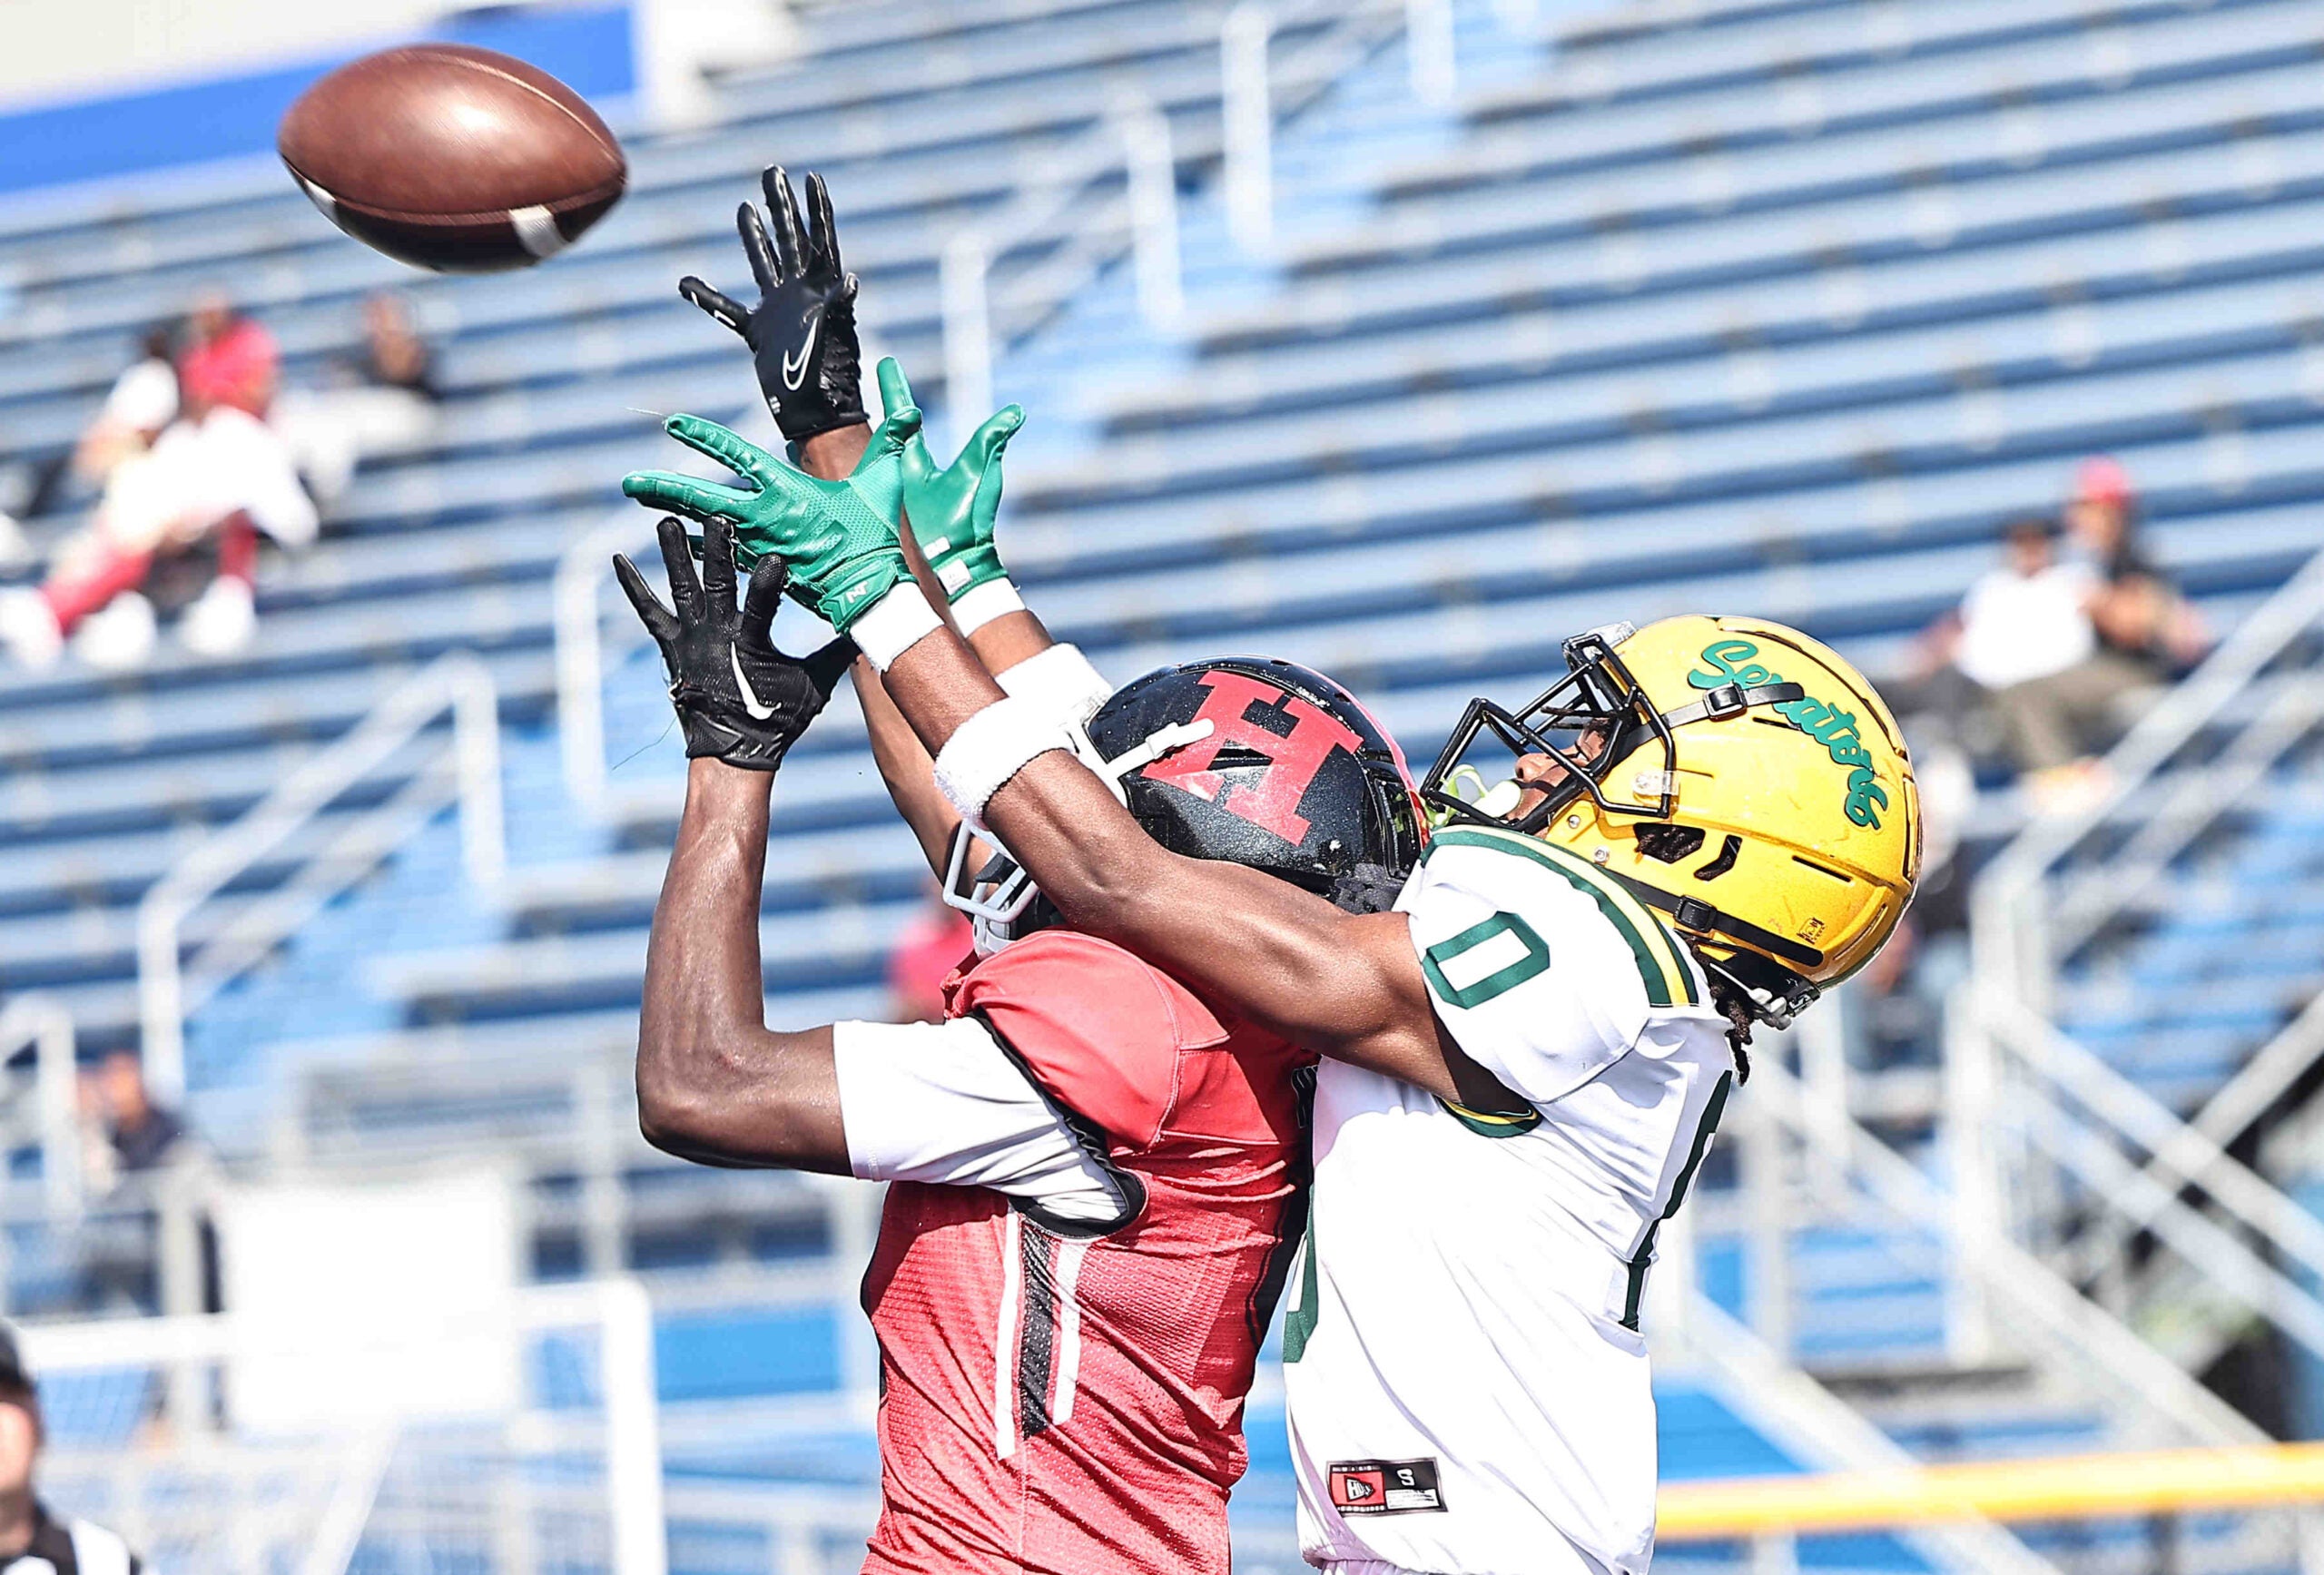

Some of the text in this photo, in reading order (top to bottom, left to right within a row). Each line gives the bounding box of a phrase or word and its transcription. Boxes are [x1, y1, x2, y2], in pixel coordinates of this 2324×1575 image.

[1140, 670, 1364, 848] H
[1687, 640, 1888, 831] Seators
[1422, 911, 1551, 1010] 0
[1396, 1468, 1415, 1487] S
